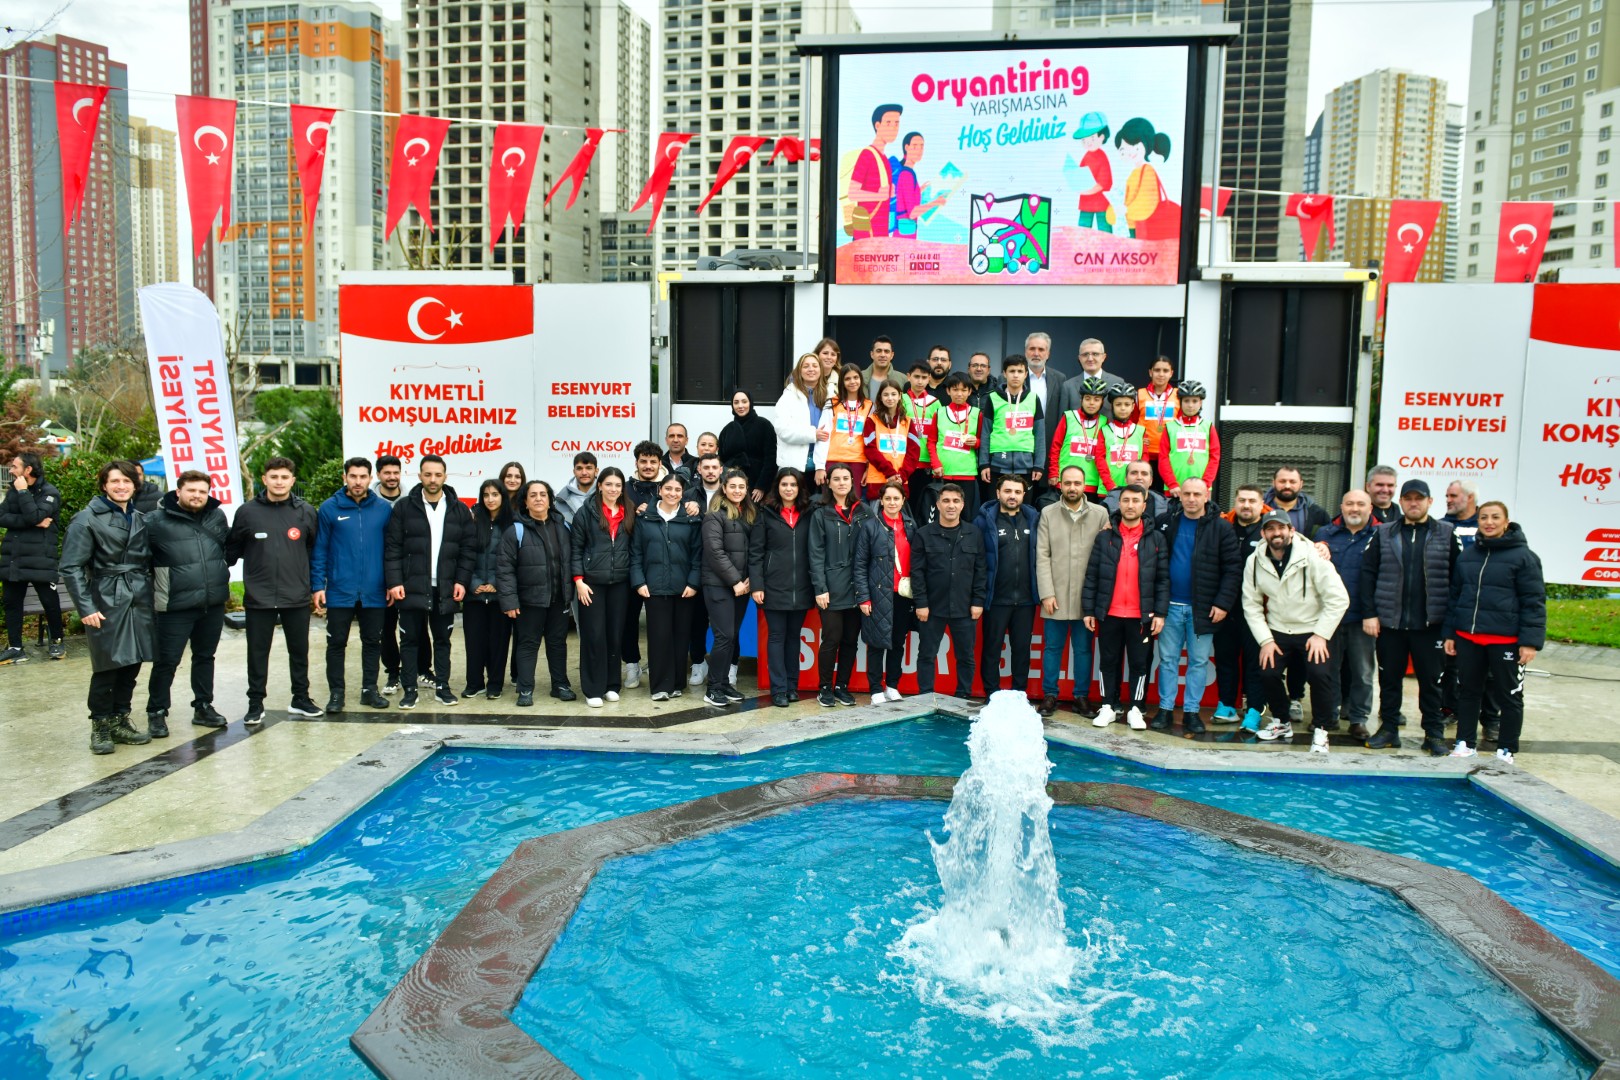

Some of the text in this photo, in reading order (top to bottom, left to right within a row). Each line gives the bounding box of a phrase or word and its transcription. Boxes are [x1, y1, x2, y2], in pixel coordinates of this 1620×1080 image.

[911, 59, 1089, 107] Oryantiring
[970, 93, 1068, 117] YARIŞMASINA
[957, 114, 1068, 153] Hoş Geldiniz
[853, 254, 900, 263] ESENYURT
[1074, 252, 1158, 265] CAN AKSOY
[389, 380, 484, 401] KIYMETLİ
[551, 382, 632, 395] ESENYURT
[1405, 392, 1504, 407] ESENYURT
[359, 406, 517, 427] KOMŞULARIMIZ
[548, 402, 636, 418] BELEDİYESİ
[1398, 415, 1507, 432] BELEDİYESİ
[375, 432, 503, 464] Hoş Geldiniz
[551, 440, 632, 452] CAN AKSOY
[1399, 456, 1498, 470] CAN AKSOY
[1559, 463, 1612, 490] Hoş
[1599, 549, 1620, 561] 44
